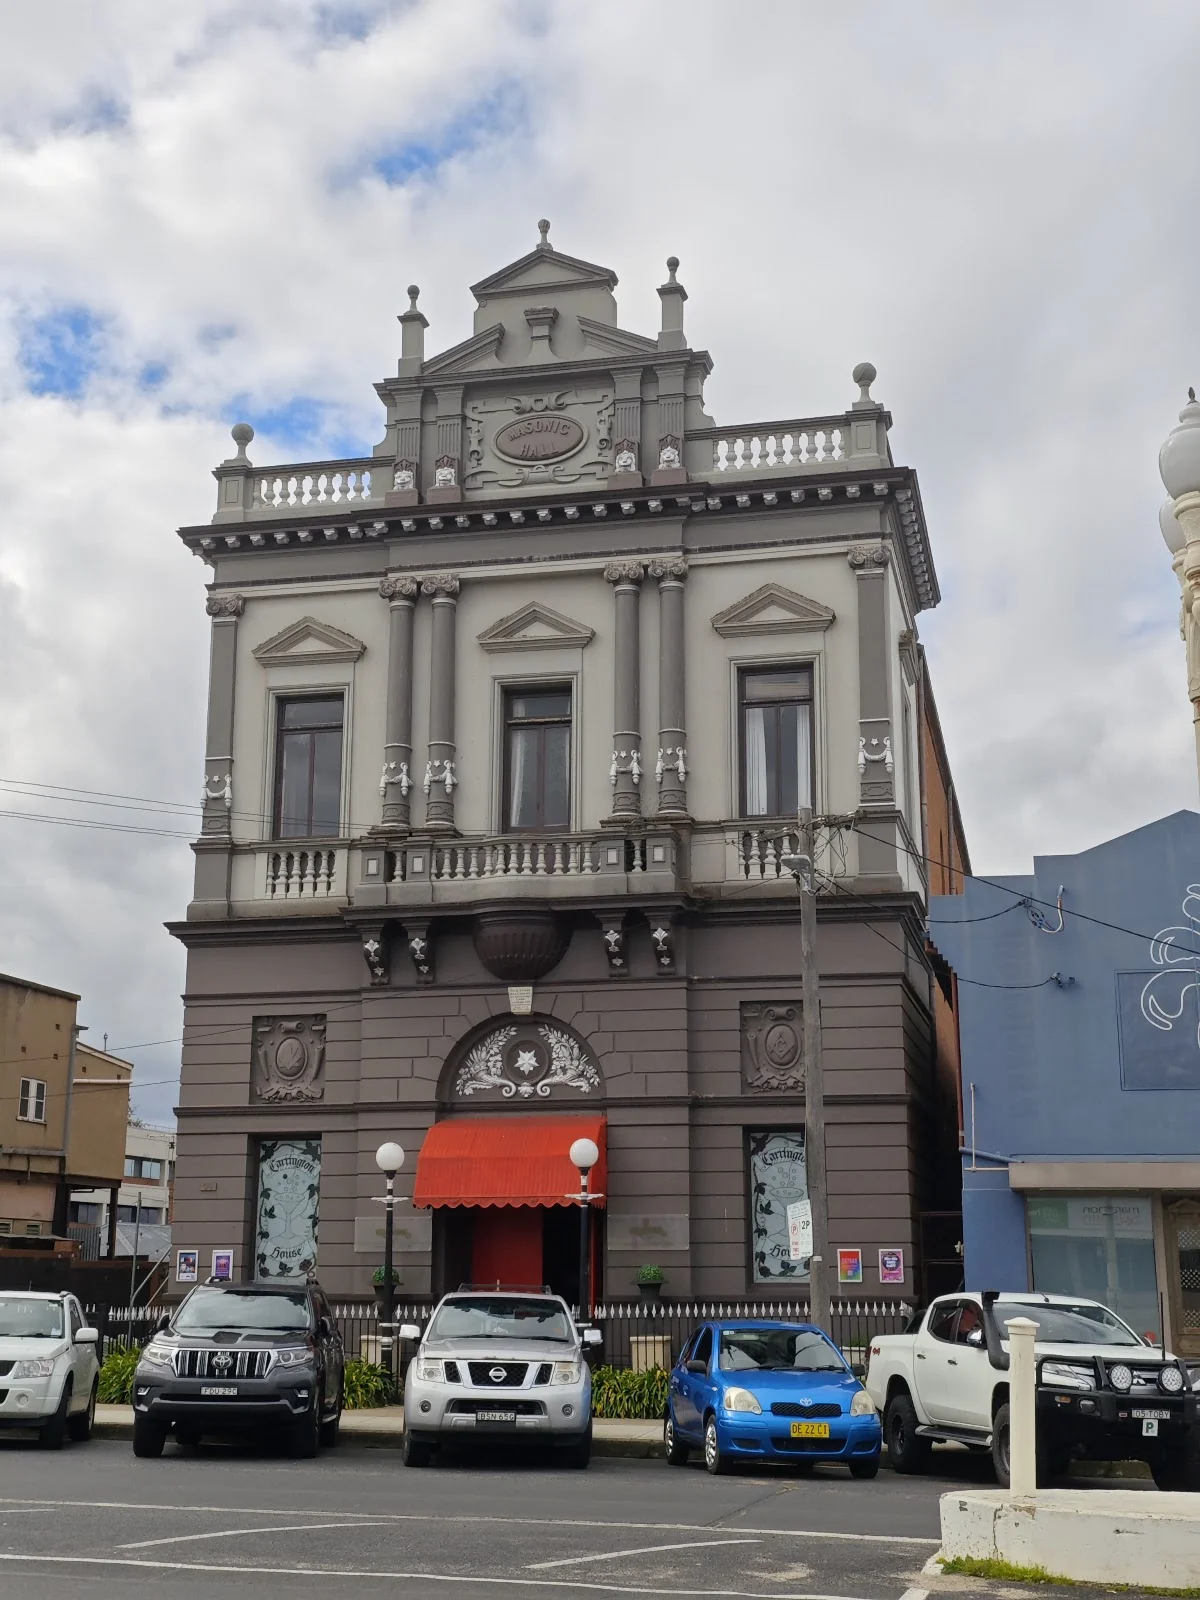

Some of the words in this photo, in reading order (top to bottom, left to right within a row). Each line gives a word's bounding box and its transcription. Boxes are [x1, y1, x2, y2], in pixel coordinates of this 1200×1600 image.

[508, 420, 570, 442] MASONIC
[520, 442, 558, 457] HALL
[269, 1154, 315, 1173] Carrington
[762, 1147, 805, 1166] Carringto
[801, 1220, 811, 1230] 2P
[270, 1246, 303, 1260] House
[1145, 1421, 1154, 1433] P
